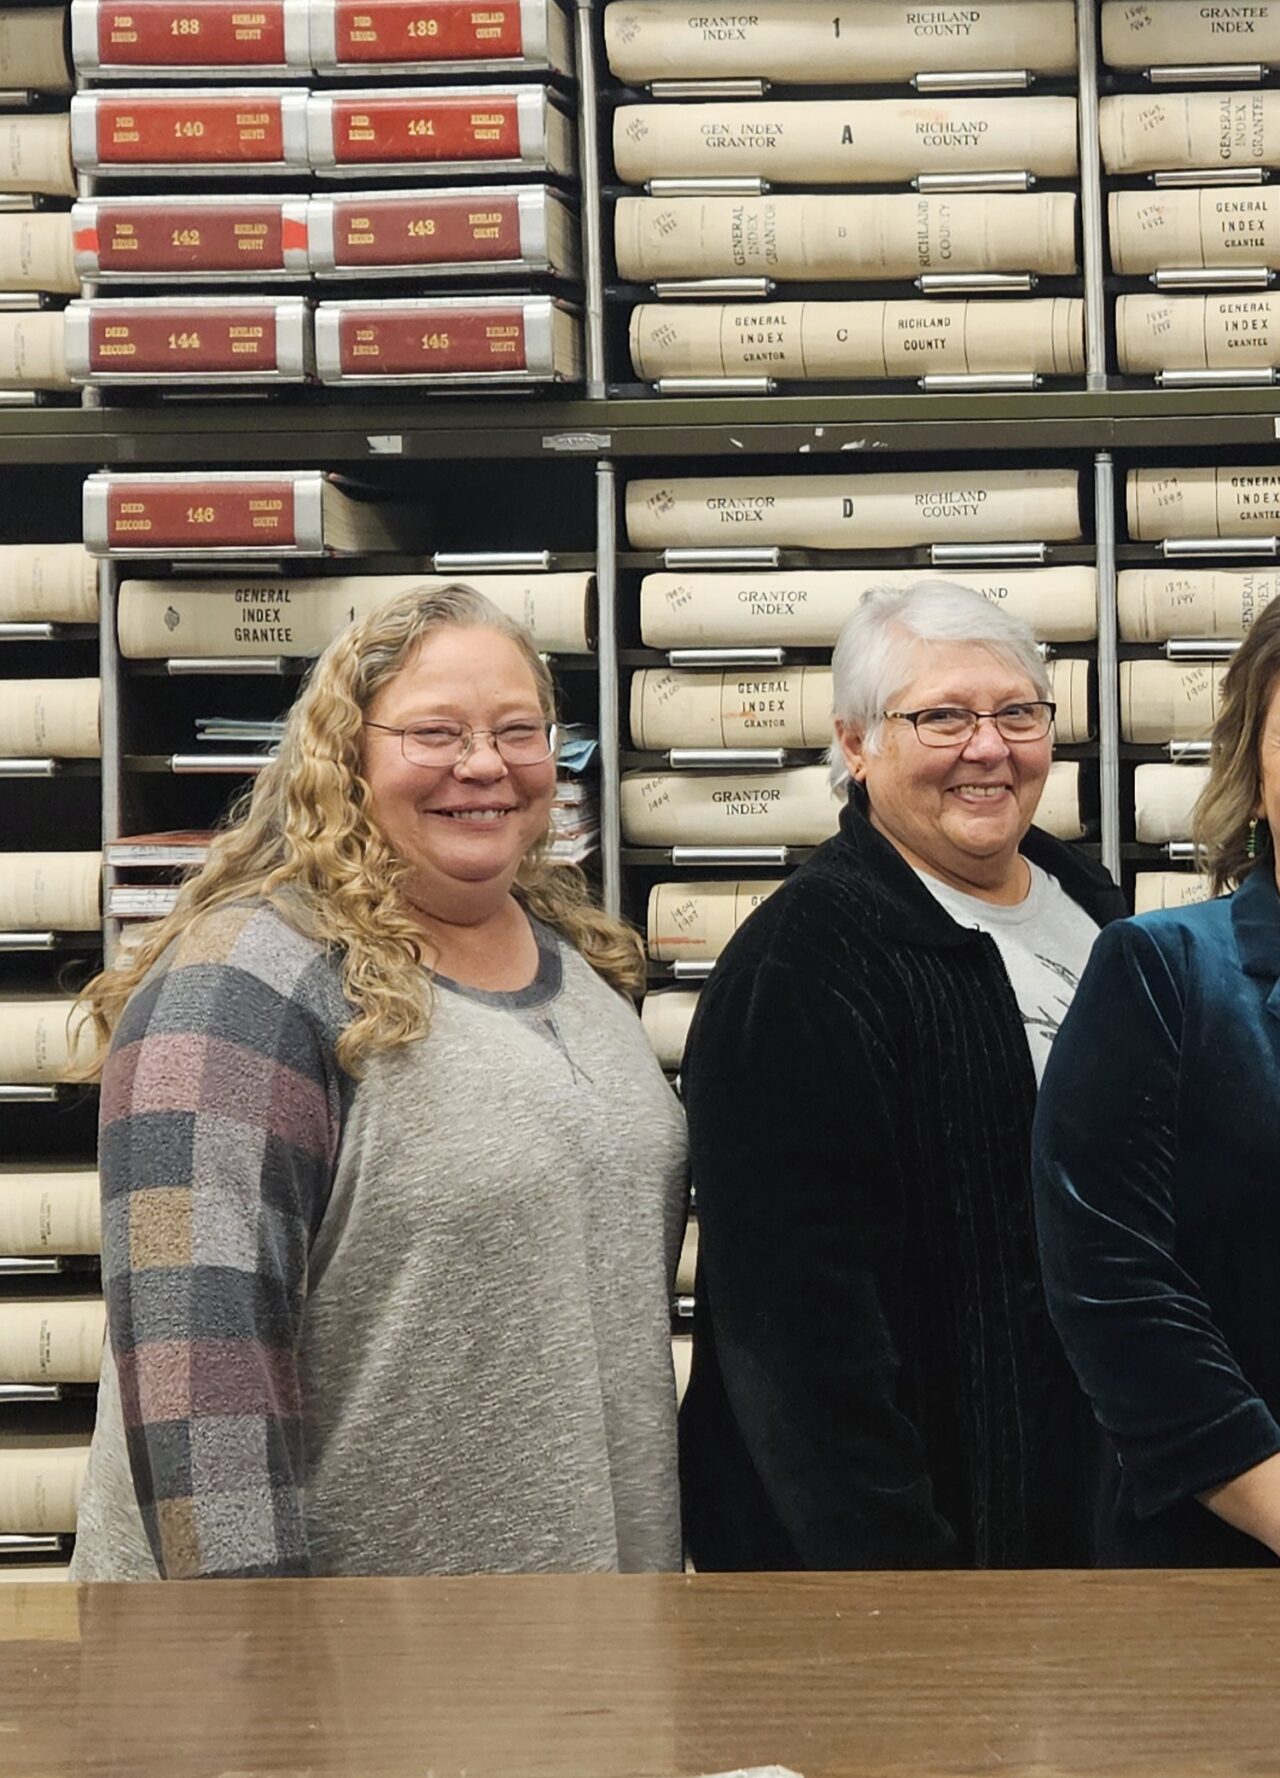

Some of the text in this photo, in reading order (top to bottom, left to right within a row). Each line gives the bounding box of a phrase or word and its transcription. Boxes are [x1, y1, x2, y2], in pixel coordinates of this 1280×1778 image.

[906, 12, 980, 24] RICHLAND
[1200, 7, 1268, 19] GRANTEE
[171, 20, 199, 35] 138
[407, 21, 438, 36] 139
[688, 16, 758, 28] GRANTOR
[832, 18, 840, 38] 1
[1211, 21, 1255, 33] INDEX
[702, 28, 745, 41] INDEX
[915, 24, 972, 37] COUNTY
[174, 121, 203, 137] 140
[407, 120, 434, 135] 141
[700, 124, 783, 135] GEN. INDEX
[915, 121, 988, 133] RICHLAND
[1220, 97, 1231, 159] GENERAL
[1251, 96, 1264, 157] GRANTEE
[841, 125, 853, 144] A
[923, 134, 979, 147] COUNTY
[706, 136, 776, 147] GRANTOR
[1216, 201, 1268, 213] GENERAL
[407, 220, 435, 236] 143
[1222, 220, 1265, 232] INDEX
[172, 230, 200, 246] 142
[733, 205, 745, 266] GENERAL
[919, 200, 929, 267] RICHLAND
[1224, 238, 1265, 248] GRANTEE
[1219, 302, 1271, 314] GENERAL
[735, 316, 787, 327] GENERAL
[898, 316, 951, 329] RICHLAND
[1225, 319, 1268, 331] INDEX
[168, 332, 200, 348] 144
[421, 334, 449, 349] 145
[741, 332, 784, 344] INDEX
[837, 329, 847, 342] C
[904, 338, 946, 351] COUNTY
[1227, 338, 1267, 348] GRANTEE
[743, 352, 785, 362] GRANTOR
[706, 497, 775, 510] GRANTOR
[915, 491, 987, 505] RICHLAND
[1237, 493, 1280, 505] INDEX
[843, 499, 853, 518] D
[922, 505, 979, 517] COUNTY
[187, 508, 214, 523] 146
[720, 510, 763, 522] INDEX
[1239, 511, 1280, 520] GRANTEE
[234, 589, 291, 603] GENERAL
[738, 591, 807, 602] GRANTOR
[242, 608, 280, 623] INDEX
[751, 603, 794, 615] INDEX
[234, 628, 293, 642] GRANTEE
[737, 681, 789, 693] GENERAL
[742, 700, 784, 712] INDEX
[744, 718, 786, 728] GRANTOR
[712, 789, 780, 803] GRANTOR
[725, 801, 768, 815] INDEX
